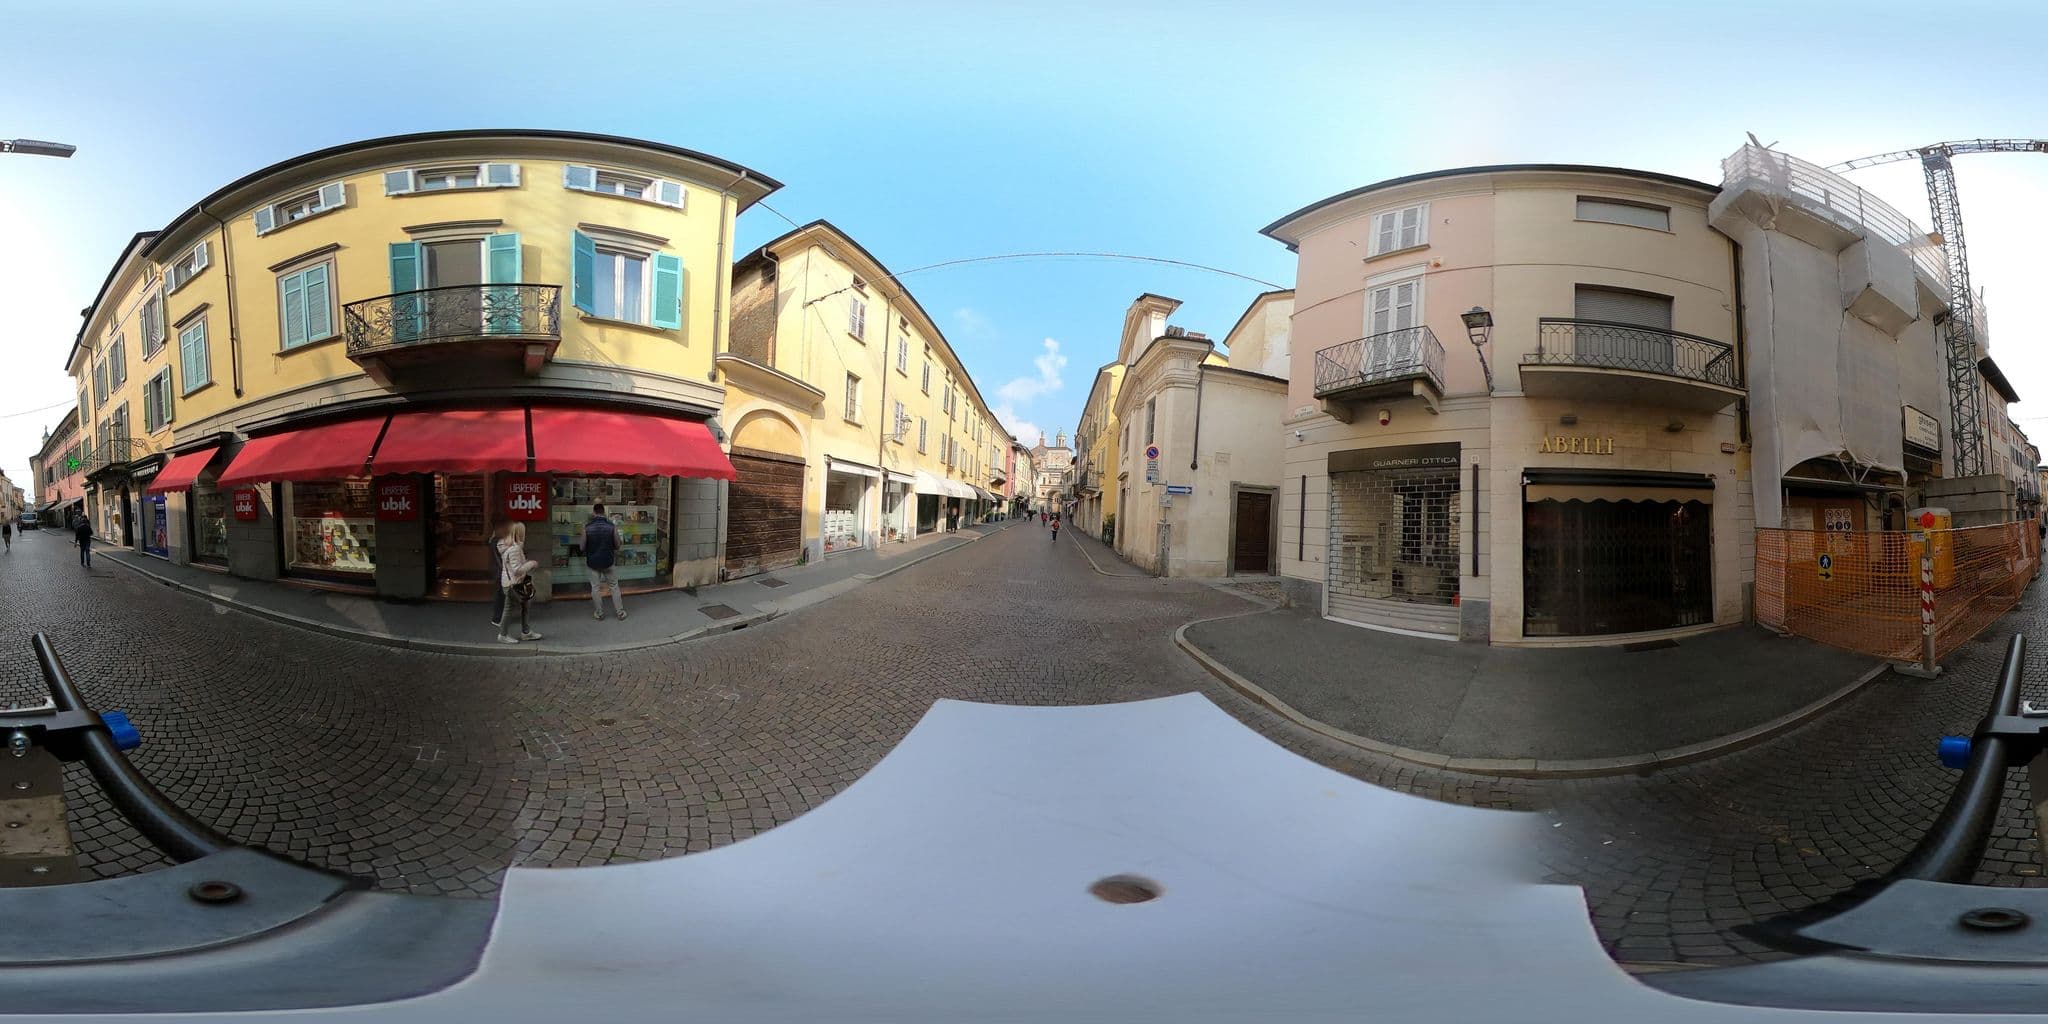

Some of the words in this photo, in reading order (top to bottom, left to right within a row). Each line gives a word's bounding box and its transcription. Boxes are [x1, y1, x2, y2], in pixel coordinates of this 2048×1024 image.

[1539, 435, 1614, 454] ABELLI
[1373, 458, 1419, 467] GUARNERI
[1421, 457, 1457, 465] OTTICA
[510, 483, 542, 493] LIBRERIE
[235, 501, 253, 515] ubik
[381, 496, 411, 515] ubik
[509, 495, 542, 514] ubik
